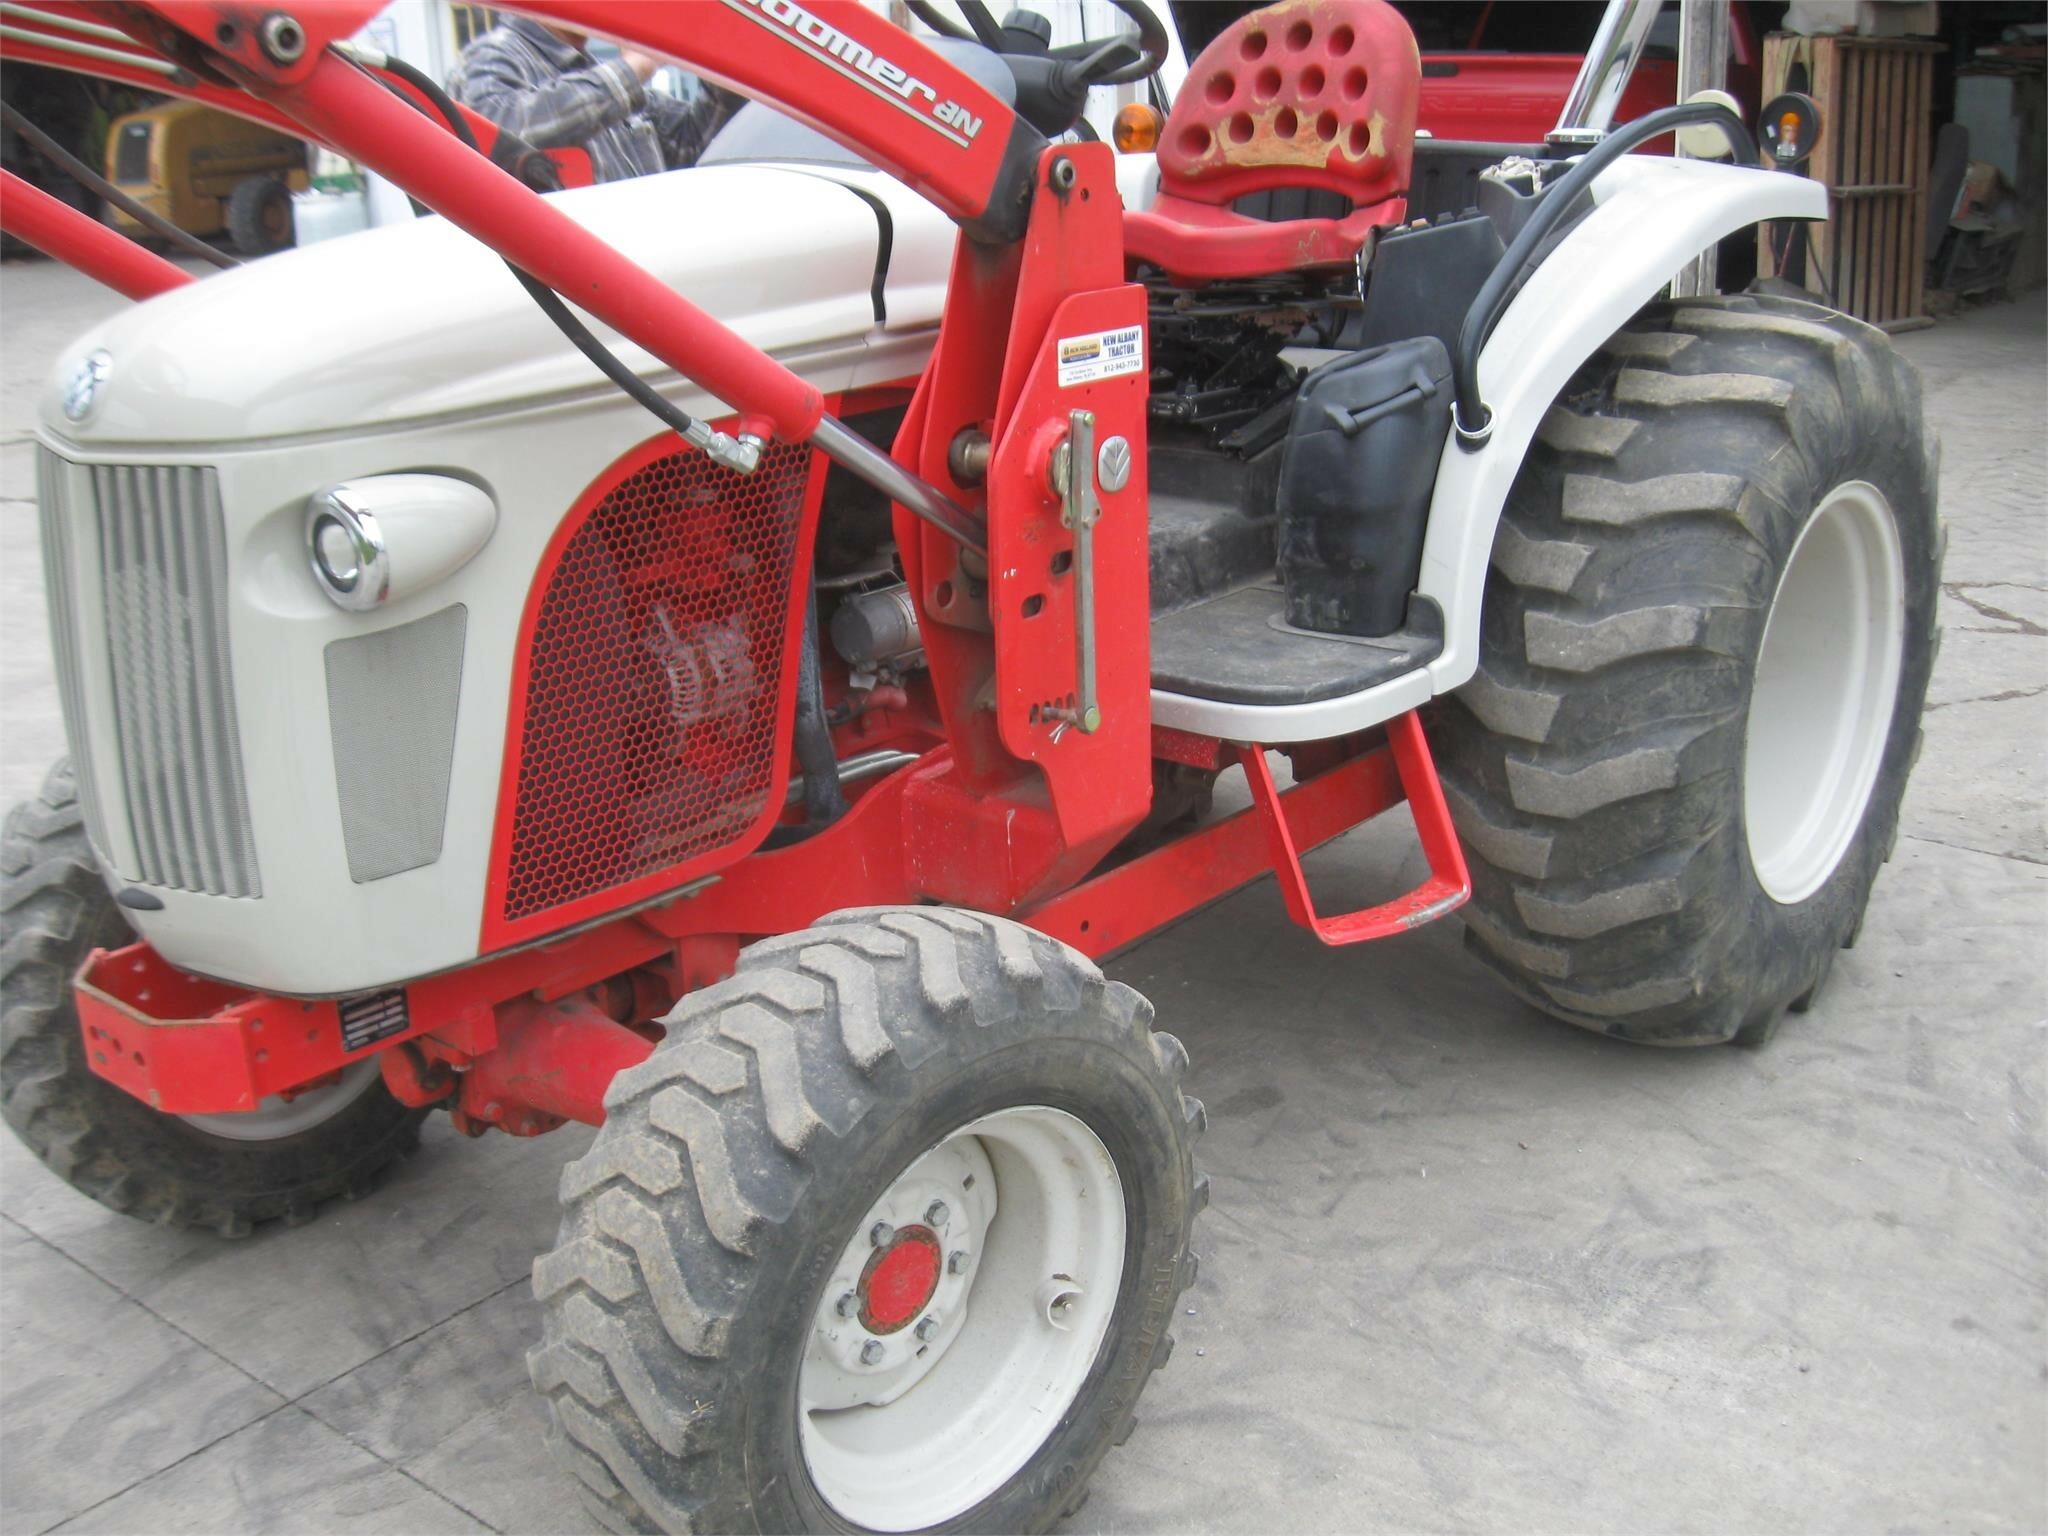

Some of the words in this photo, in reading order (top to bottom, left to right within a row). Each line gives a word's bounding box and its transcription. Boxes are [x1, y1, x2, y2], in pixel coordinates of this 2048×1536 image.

[745, 0, 937, 101] oomer
[932, 99, 983, 138] 8N
[1103, 335, 1116, 346] NEW
[1117, 330, 1139, 343] ALBANY
[1108, 343, 1135, 357] TRACTOR
